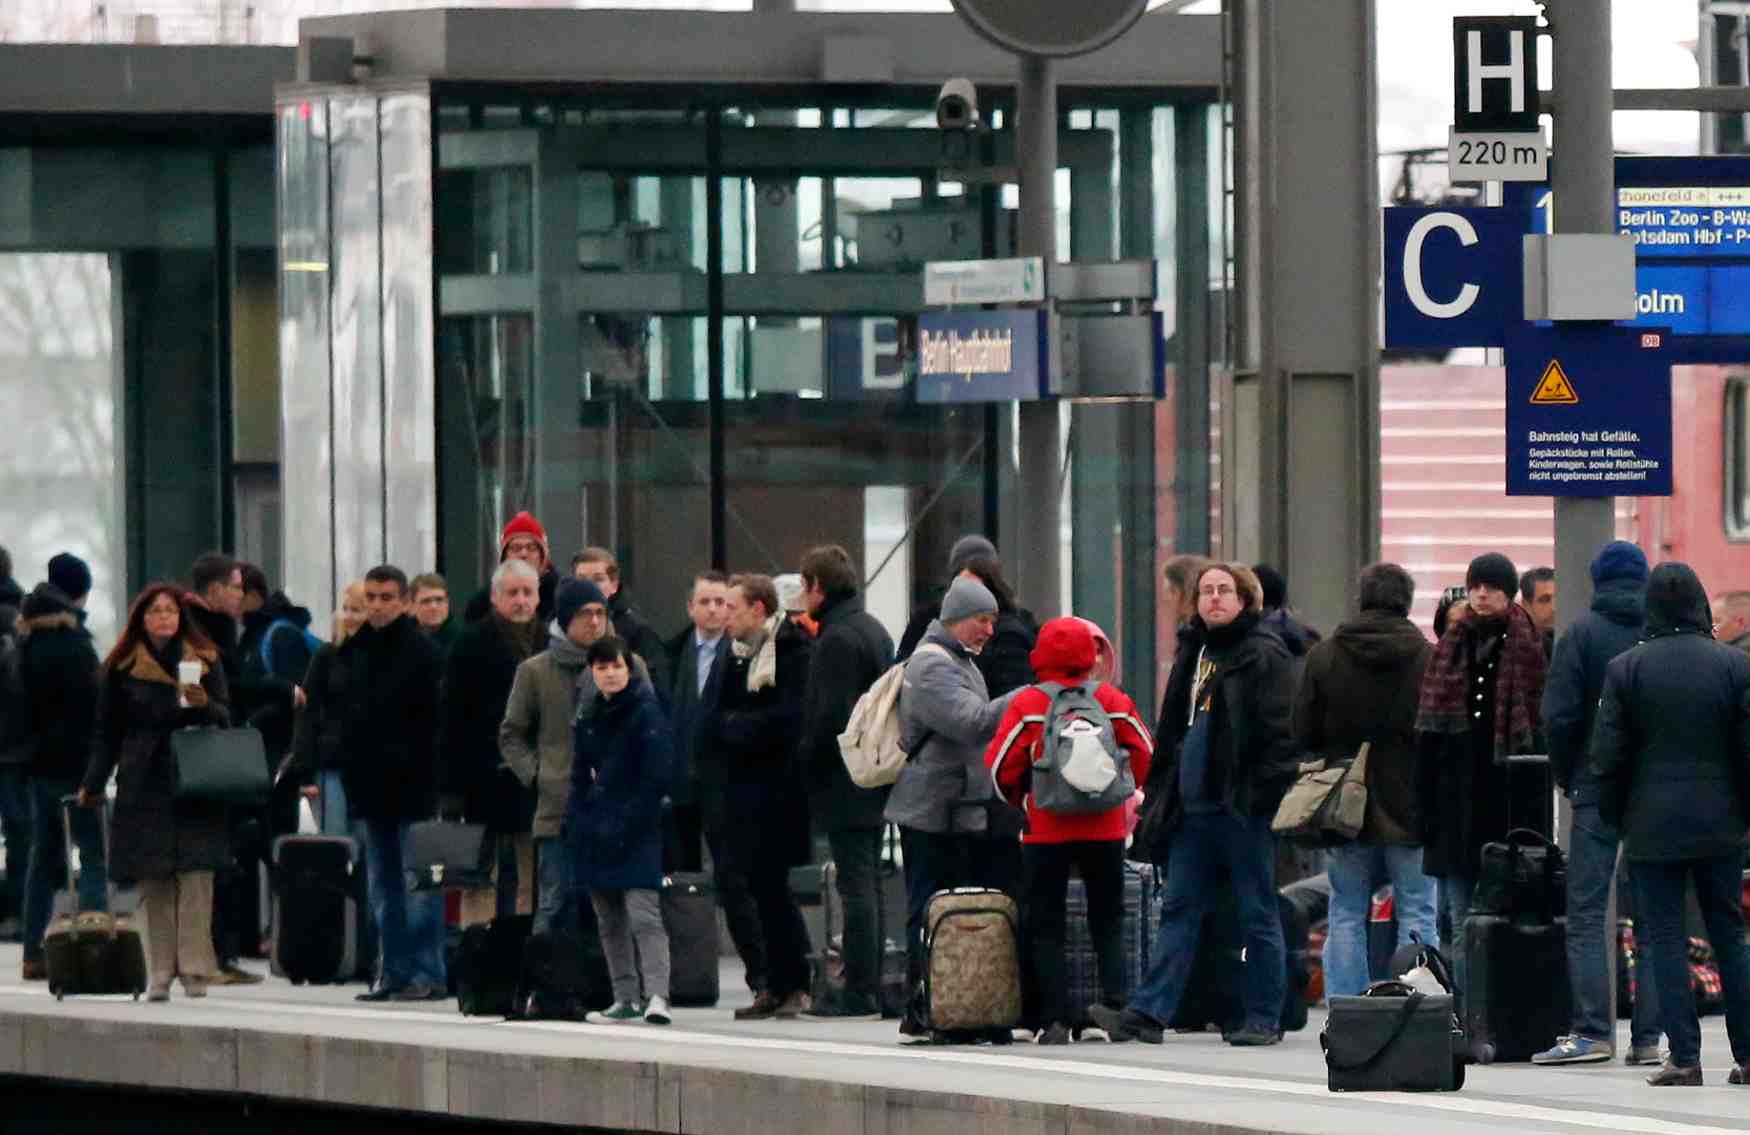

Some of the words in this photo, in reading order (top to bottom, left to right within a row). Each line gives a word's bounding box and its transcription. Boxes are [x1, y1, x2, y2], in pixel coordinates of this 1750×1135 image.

[1467, 30, 1525, 113] H
[1458, 141, 1507, 165] 220
[1513, 145, 1537, 164] m
[1620, 210, 1665, 226] Berlin
[1671, 210, 1699, 226] Zoo
[1695, 228, 1723, 245] Hbf
[1403, 211, 1481, 319] C
[1634, 288, 1684, 313] olm
[920, 328, 949, 376] Berlin
[1528, 431, 1579, 444] Bahnsteig
[1582, 430, 1599, 442] hat
[1601, 430, 1641, 442] Gefälle.
[1528, 472, 1551, 481] nicht
